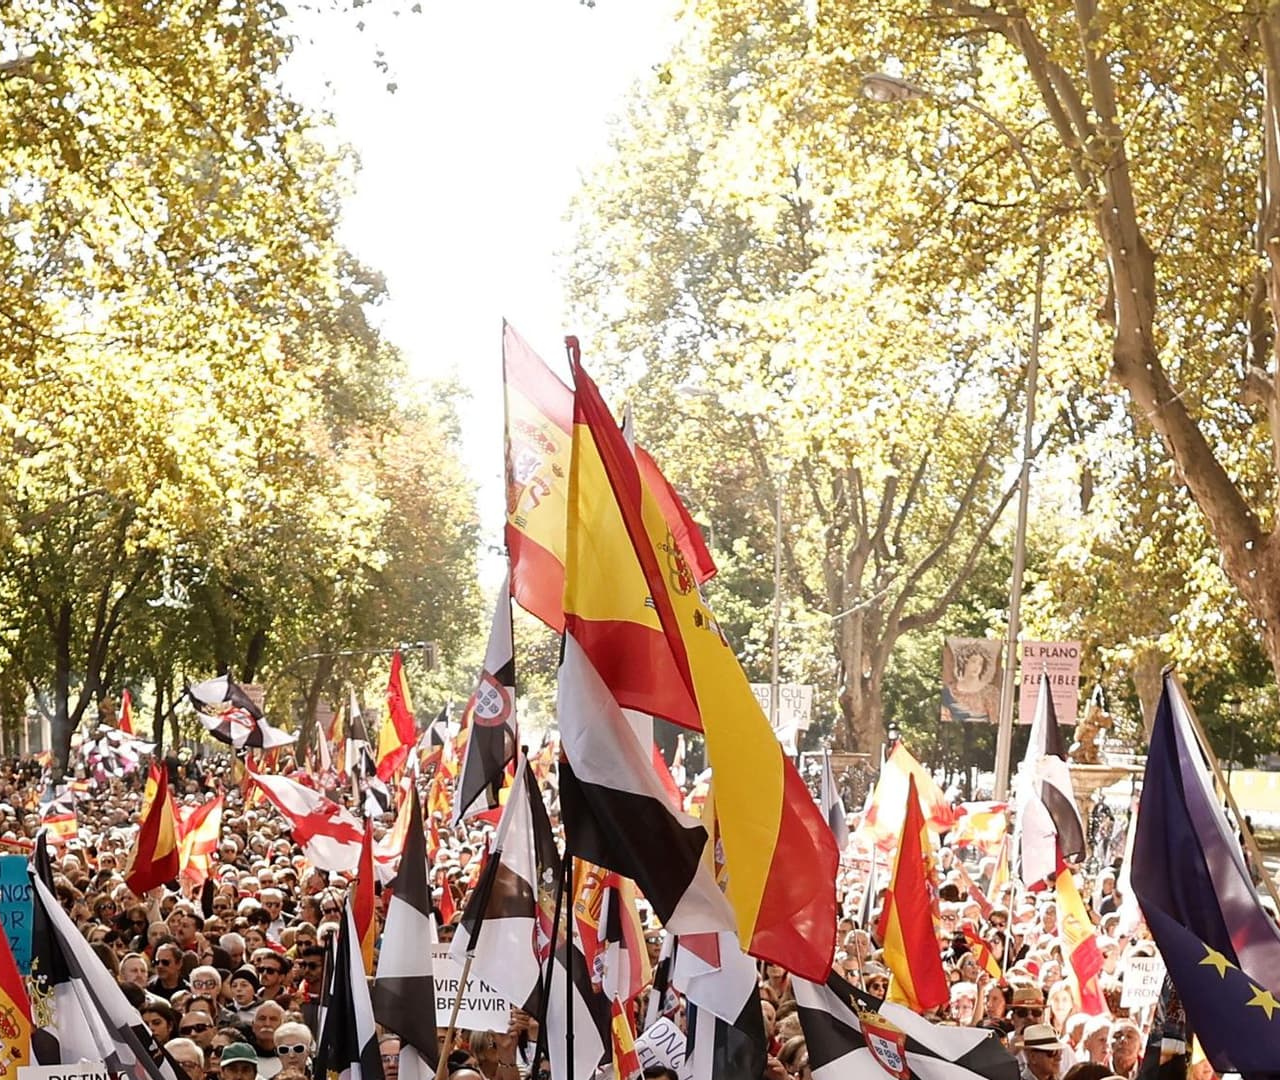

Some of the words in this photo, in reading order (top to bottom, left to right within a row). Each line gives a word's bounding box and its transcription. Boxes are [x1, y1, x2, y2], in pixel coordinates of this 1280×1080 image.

[1024, 646, 1034, 657] EL
[1040, 647, 1078, 659] PLANO
[1024, 674, 1077, 686] FLEIBLE
